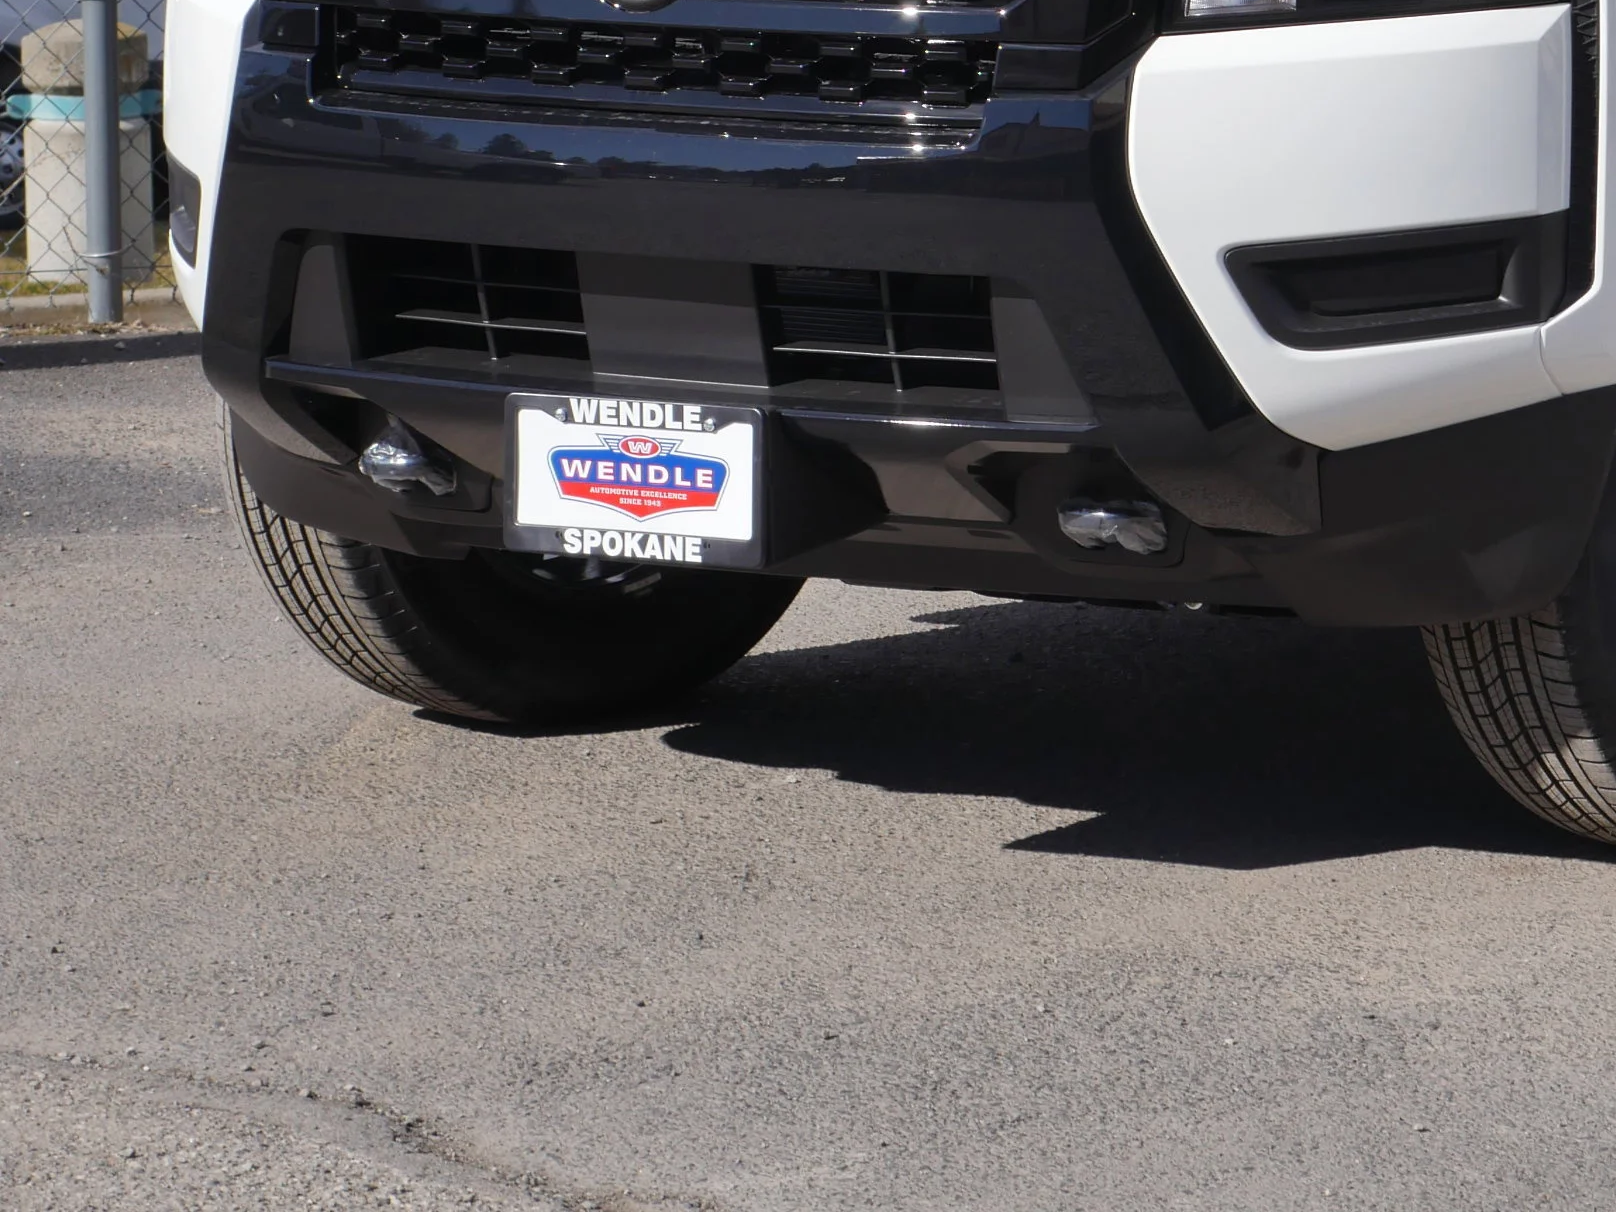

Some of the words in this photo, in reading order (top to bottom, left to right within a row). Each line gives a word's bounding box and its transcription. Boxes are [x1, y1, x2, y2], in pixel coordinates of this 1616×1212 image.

[569, 397, 703, 431] WENDLE
[560, 458, 714, 488] WENDLE
[589, 486, 639, 497] AUTOMOTIVE
[640, 490, 688, 501] EXCELLENCE
[619, 497, 642, 506] SINCE
[563, 528, 703, 563] SPOKANE
